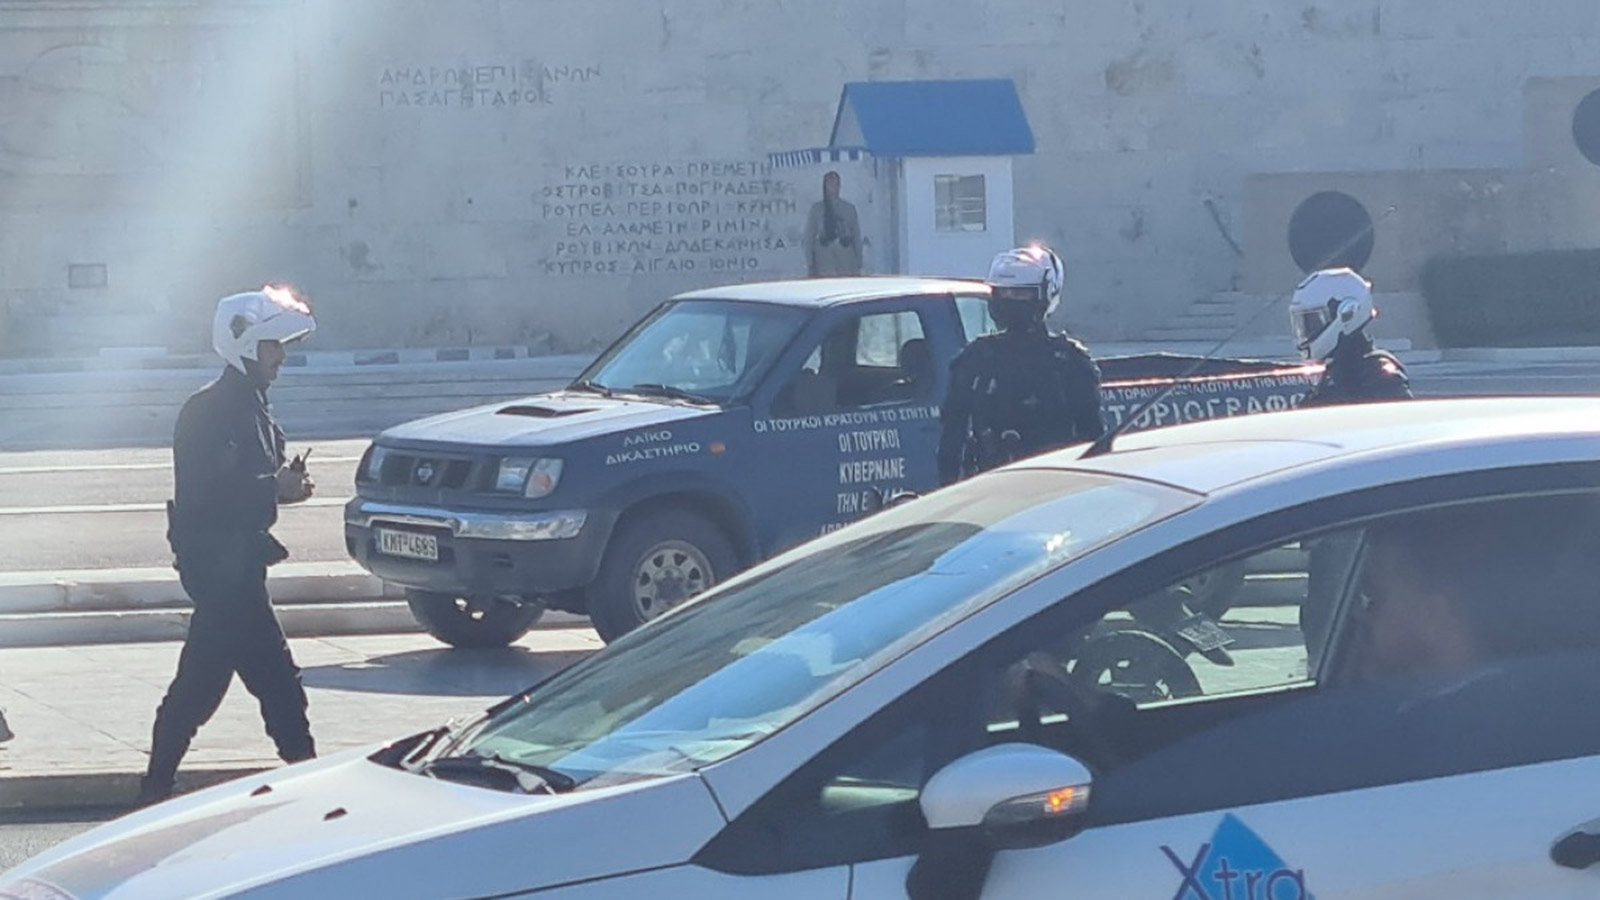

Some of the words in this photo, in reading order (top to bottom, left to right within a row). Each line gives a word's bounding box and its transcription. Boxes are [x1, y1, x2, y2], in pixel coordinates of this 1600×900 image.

[710, 256, 758, 271] ΙΟΝΙΟ
[753, 419, 767, 433] ΟΙ
[769, 416, 822, 432] ΤΟΥΡΚΟΙ
[823, 411, 879, 427] ΚΡΑΤΟΥΝ
[880, 409, 898, 422] ΤΟ
[898, 406, 929, 421] ΣΠΙΤΙ
[605, 441, 700, 465] ΔΙΚΑΣΤΗΡΙΟ
[838, 432, 851, 453] ΟΙ
[851, 428, 901, 452] ΤΟΥΡΚΟΙ
[839, 457, 906, 484] ΚΥΒΕΡΝΑΝΕ
[837, 492, 860, 514] ΤΗΝ
[1159, 842, 1305, 900] Xtra
